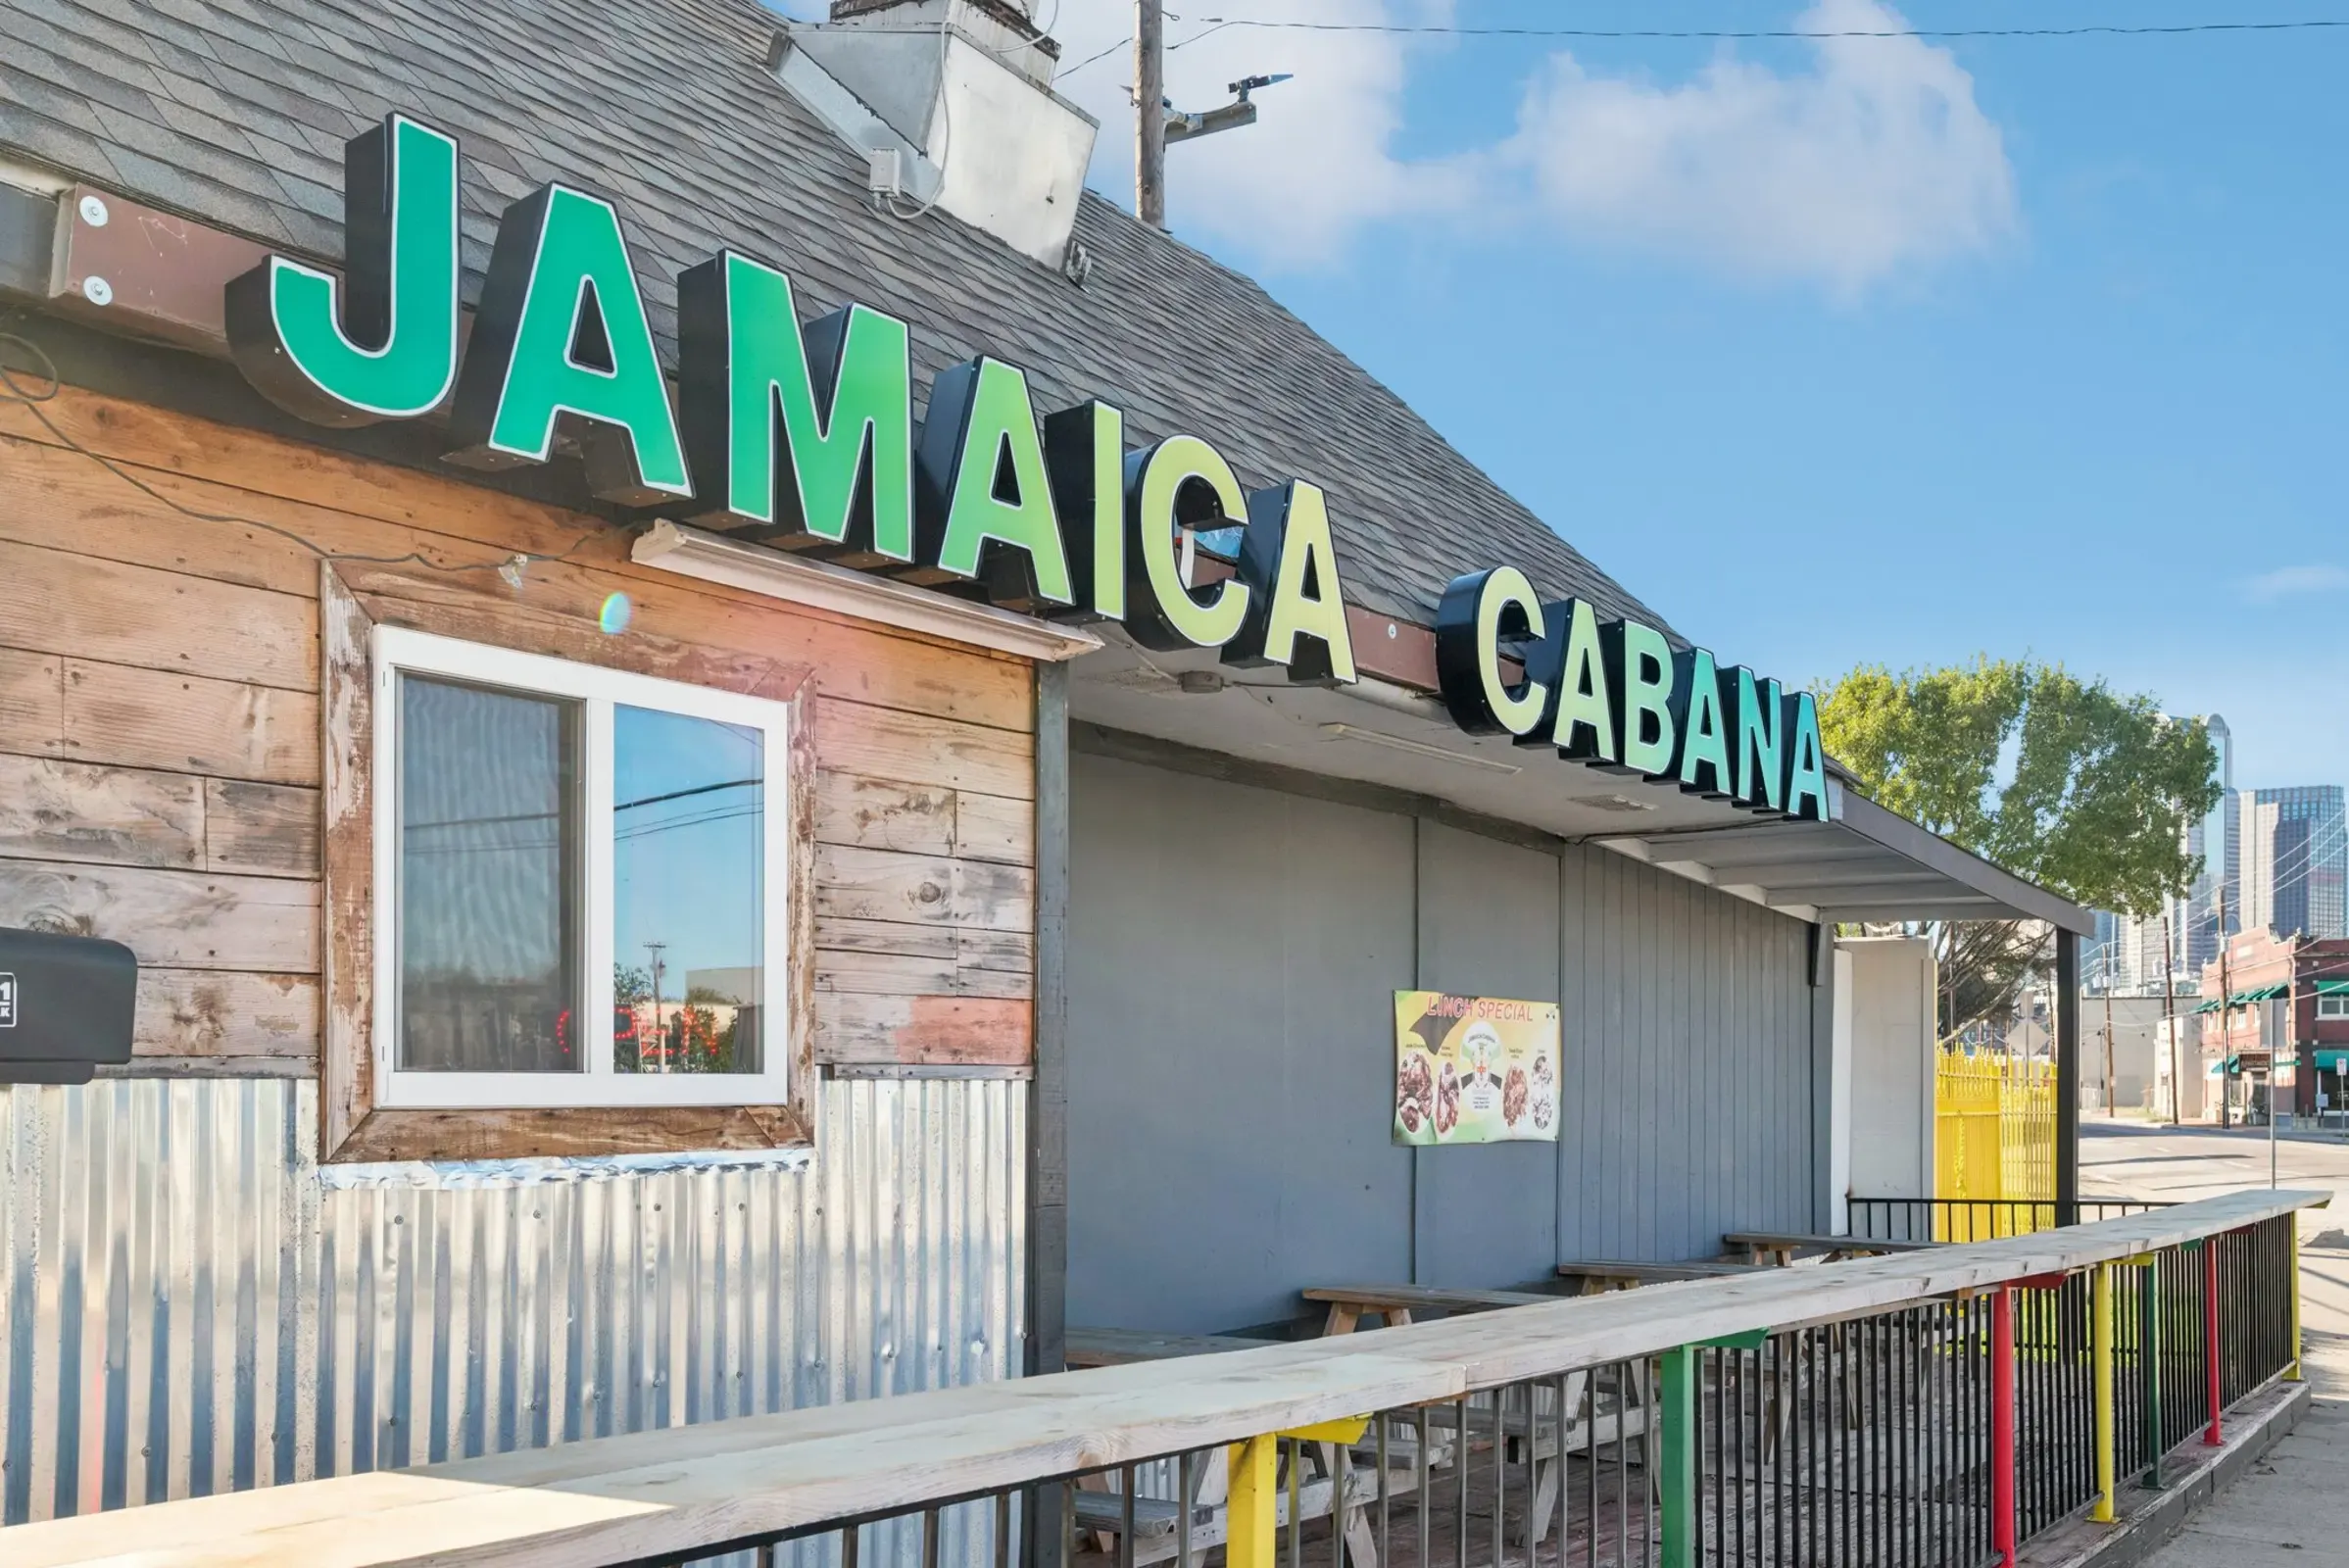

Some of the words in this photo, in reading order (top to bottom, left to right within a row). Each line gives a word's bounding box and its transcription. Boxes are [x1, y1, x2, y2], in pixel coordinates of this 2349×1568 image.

[259, 111, 1358, 685] JAMAICA
[1465, 564, 1831, 823] CABANA
[1478, 1000, 1534, 1022] SPECIAL
